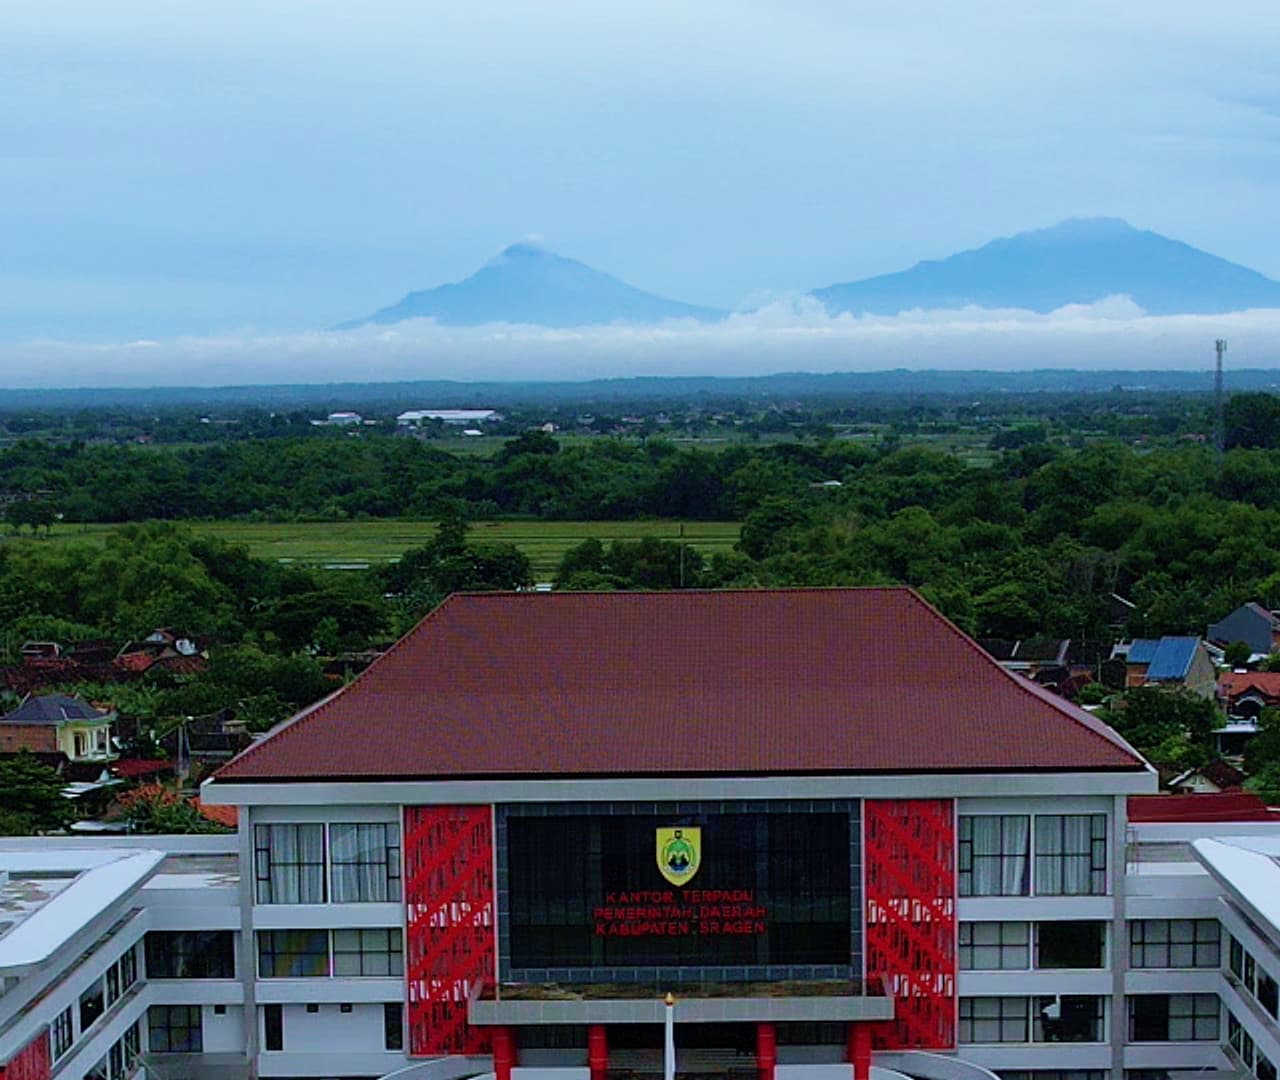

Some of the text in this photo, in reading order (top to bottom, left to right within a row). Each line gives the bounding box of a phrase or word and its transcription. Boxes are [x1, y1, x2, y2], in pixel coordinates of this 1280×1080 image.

[606, 891, 673, 904] KANTOR
[699, 905, 766, 919] DAERAH
[595, 921, 765, 937] KABUPATEN SRAGEN
